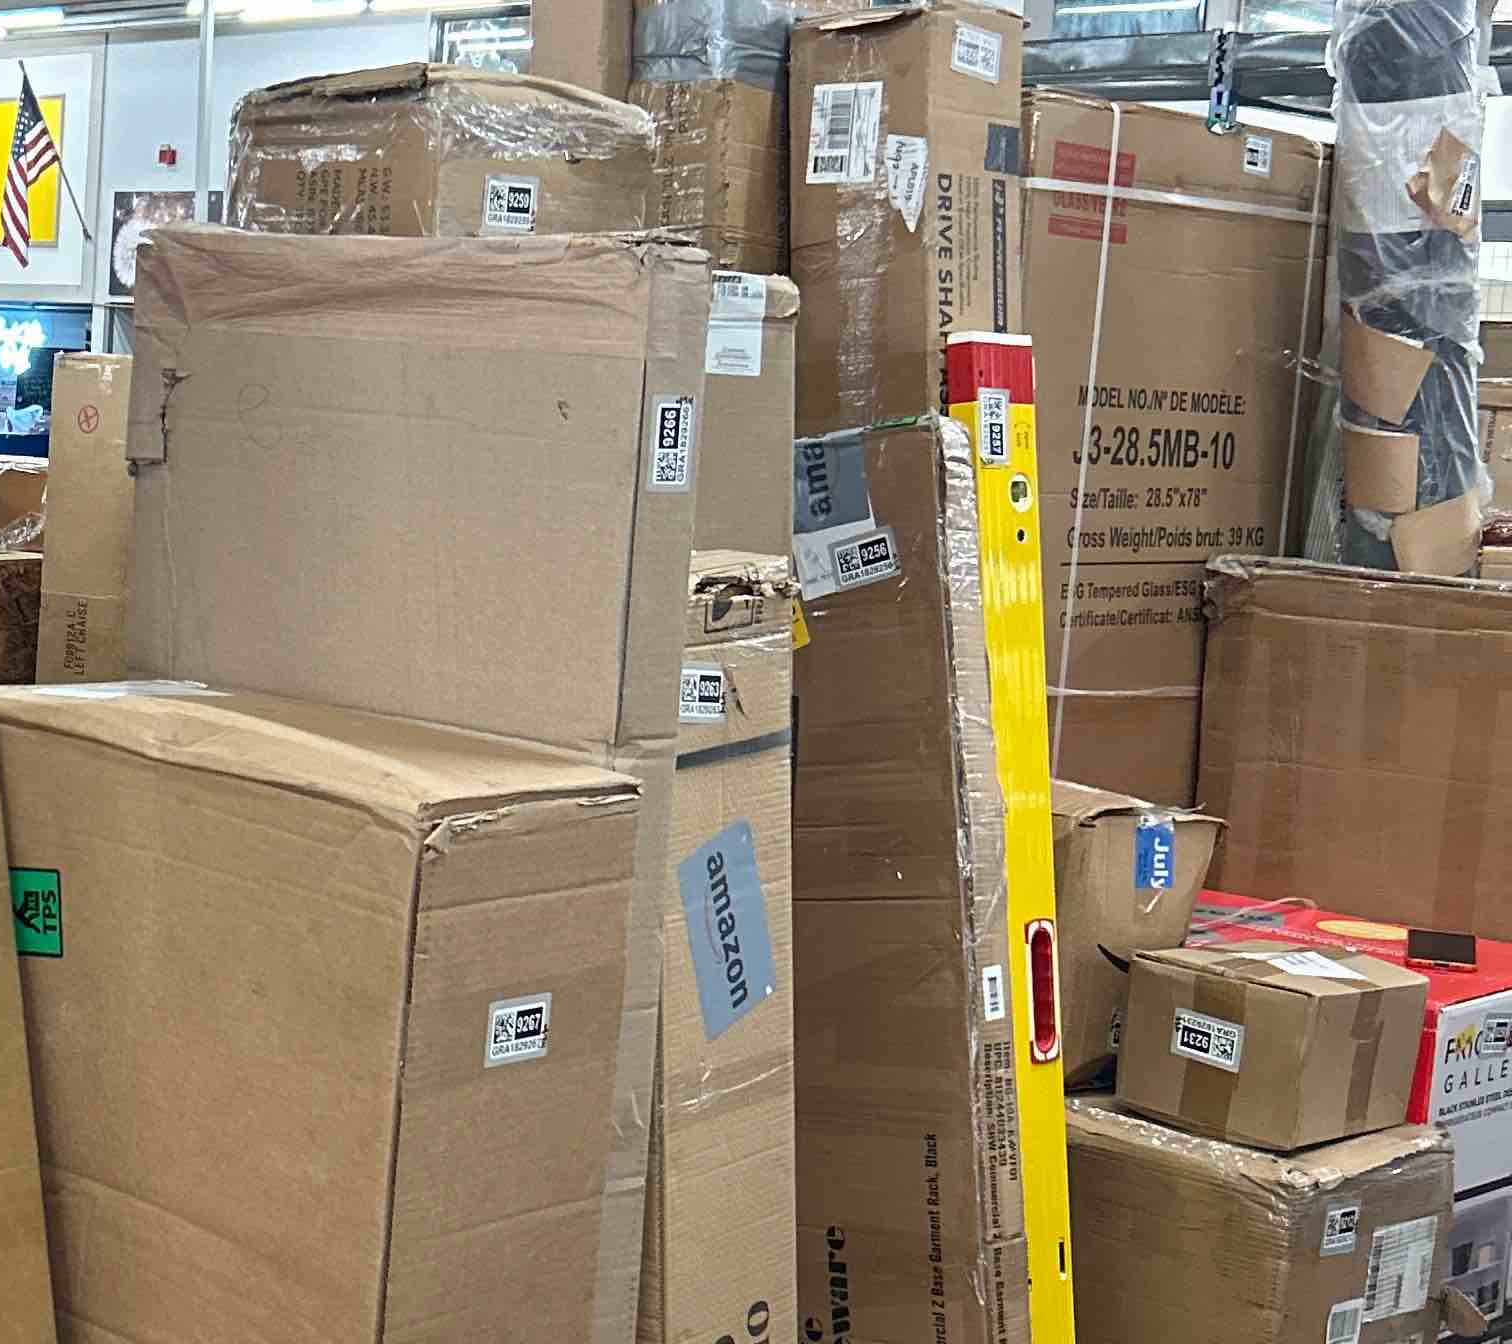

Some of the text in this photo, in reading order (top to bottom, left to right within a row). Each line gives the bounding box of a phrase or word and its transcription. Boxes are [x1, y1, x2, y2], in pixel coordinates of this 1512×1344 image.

[938, 172, 953, 262] DRIVE
[1169, 391, 1189, 412] DE
[1190, 388, 1247, 416] MODÈLE:
[662, 409, 677, 448] 9266
[1069, 487, 1138, 510] Sze/Taille:
[860, 542, 888, 562] 9256
[1109, 525, 1193, 553] Weight/Poids
[1195, 526, 1224, 548] brut:
[1228, 527, 1244, 547] 39
[1245, 526, 1265, 548] KG
[1060, 582, 1085, 601] EG
[1086, 580, 1139, 602] Tempered
[1059, 608, 1174, 630] Crtificate/Certificat:
[1149, 836, 1170, 889] July
[42, 890, 58, 935] TPS
[706, 850, 749, 1009] amazon
[516, 1013, 542, 1034] 9267
[1183, 1030, 1209, 1050] 9231
[924, 1133, 938, 1169] Black
[928, 1211, 943, 1264] Garment
[930, 1266, 944, 1297] Base
